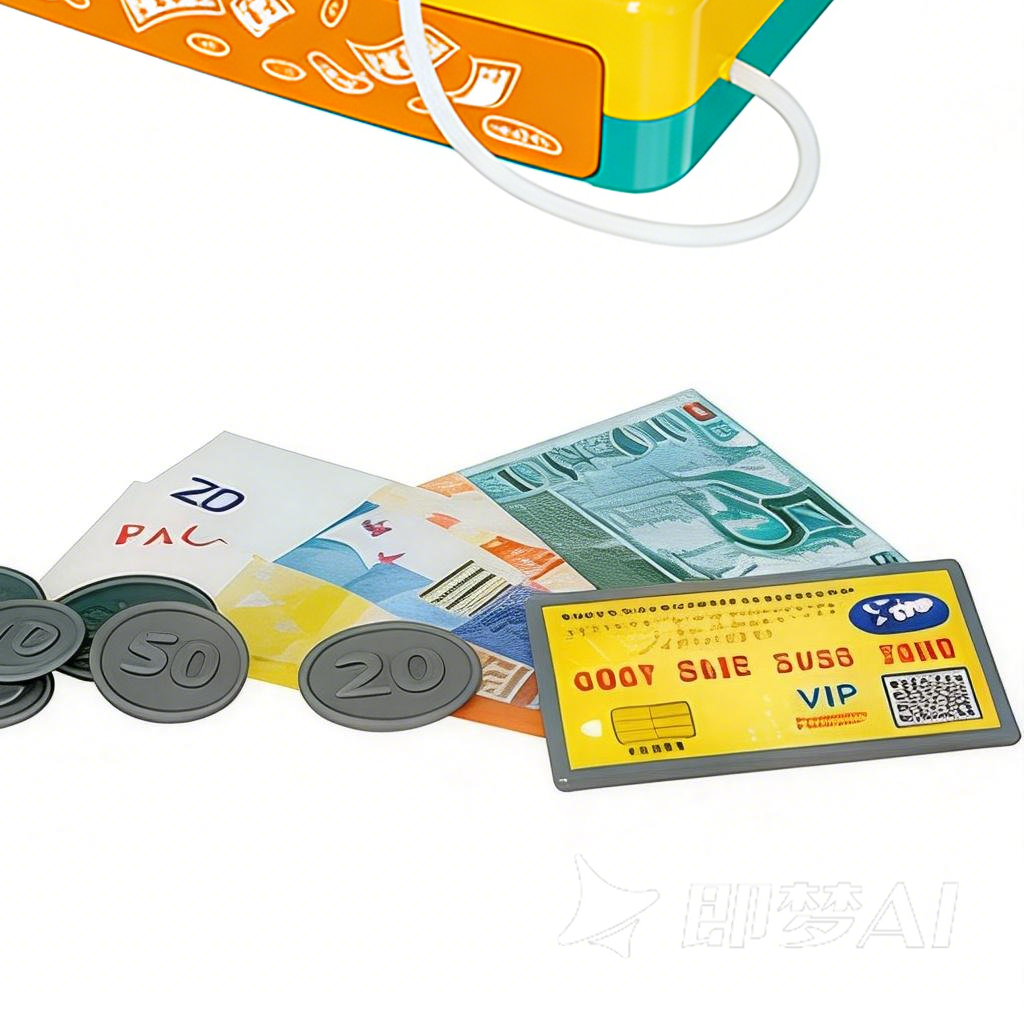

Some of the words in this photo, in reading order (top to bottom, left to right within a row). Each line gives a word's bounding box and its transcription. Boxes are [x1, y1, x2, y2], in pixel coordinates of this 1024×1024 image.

[119, 632, 222, 688] 50
[333, 647, 447, 699] 20
[796, 684, 858, 710] VIP
